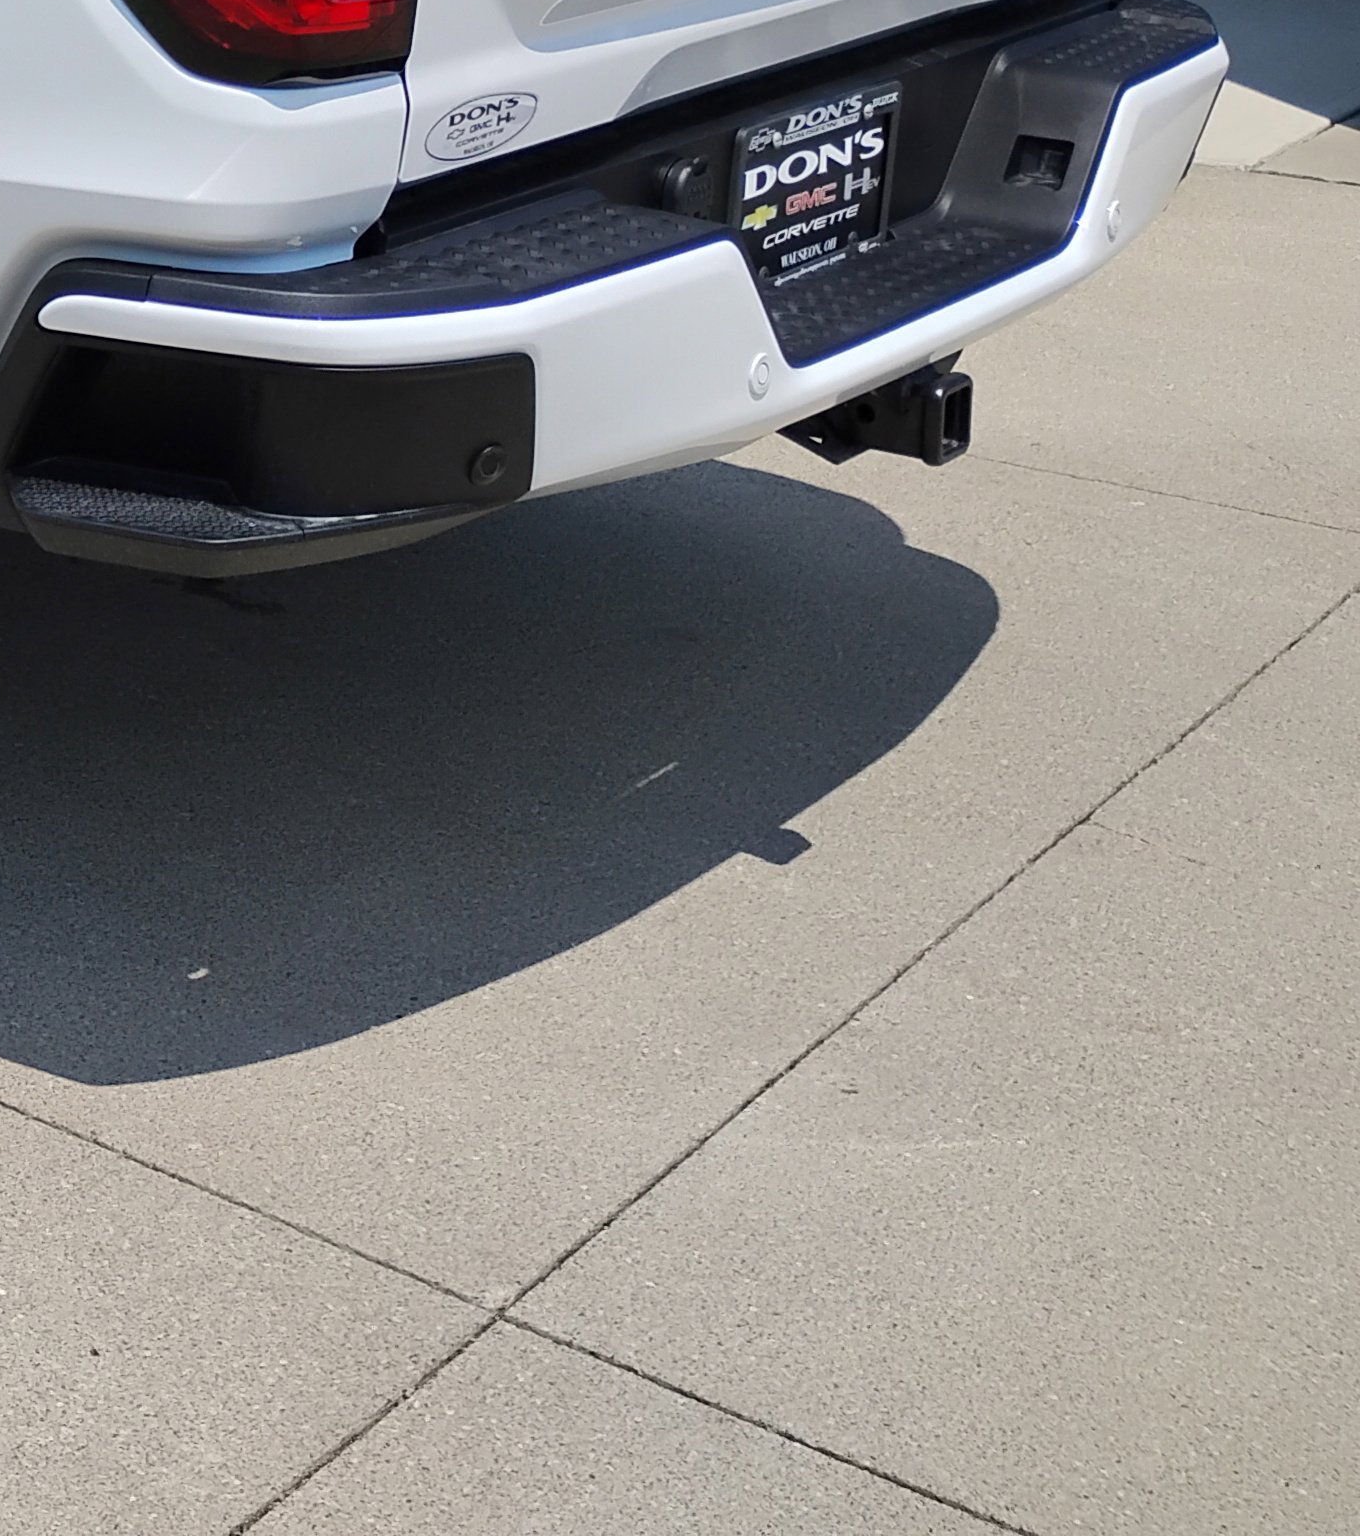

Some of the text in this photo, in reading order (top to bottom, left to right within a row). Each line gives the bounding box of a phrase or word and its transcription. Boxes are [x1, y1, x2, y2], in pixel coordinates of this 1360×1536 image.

[449, 96, 520, 127] DON'S
[785, 94, 863, 133] DON'S
[743, 127, 885, 201] DON'S
[785, 182, 837, 216] GMC
[762, 203, 860, 250] CORVETTE
